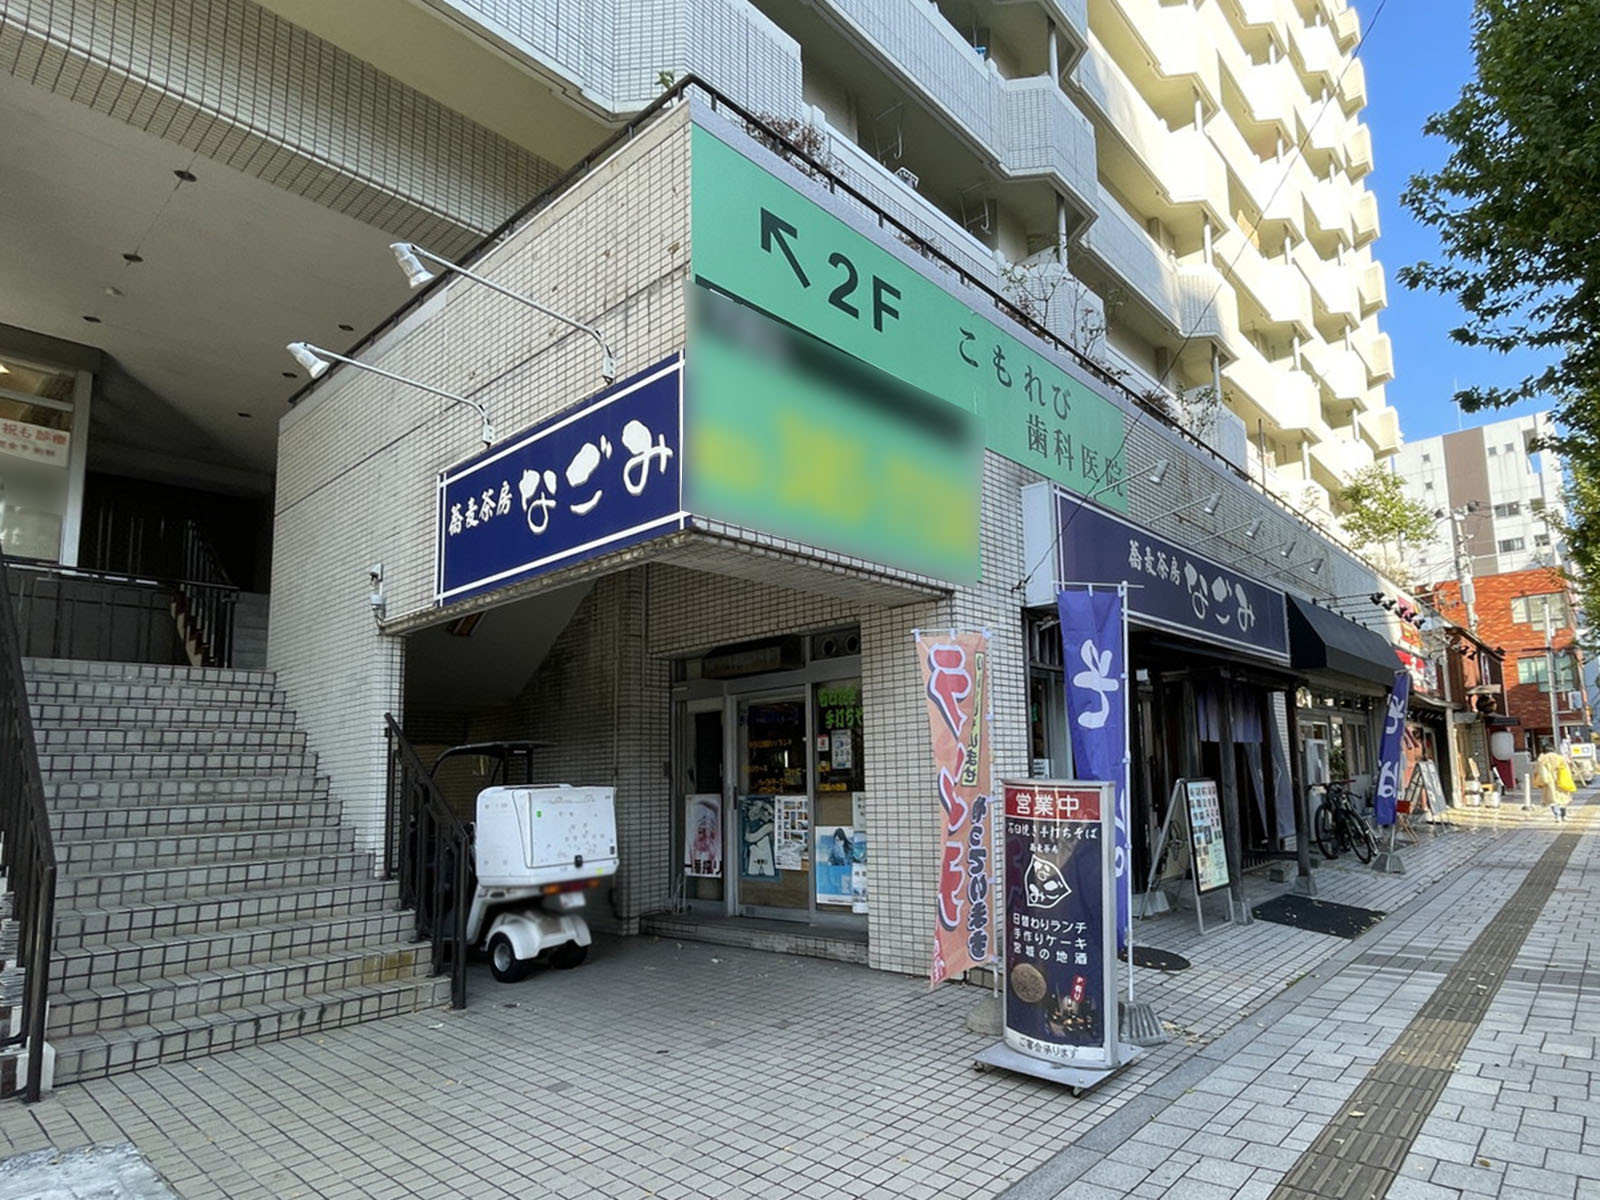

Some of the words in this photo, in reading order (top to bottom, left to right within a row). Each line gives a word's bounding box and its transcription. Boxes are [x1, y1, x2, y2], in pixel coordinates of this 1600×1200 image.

[827, 252, 902, 333] 2F
[958, 326, 1071, 421] こもれび
[448, 480, 514, 536] 蕎麦茶房
[518, 419, 674, 535] なごみ
[1026, 413, 1124, 498] 歯科医院
[1128, 539, 1181, 587] 蕎麦茶房
[1184, 560, 1256, 633] なごみ
[1015, 792, 1079, 817] 営業中
[1013, 911, 1088, 935] 日替わりランチ
[1013, 929, 1088, 951] 手作りケーキ
